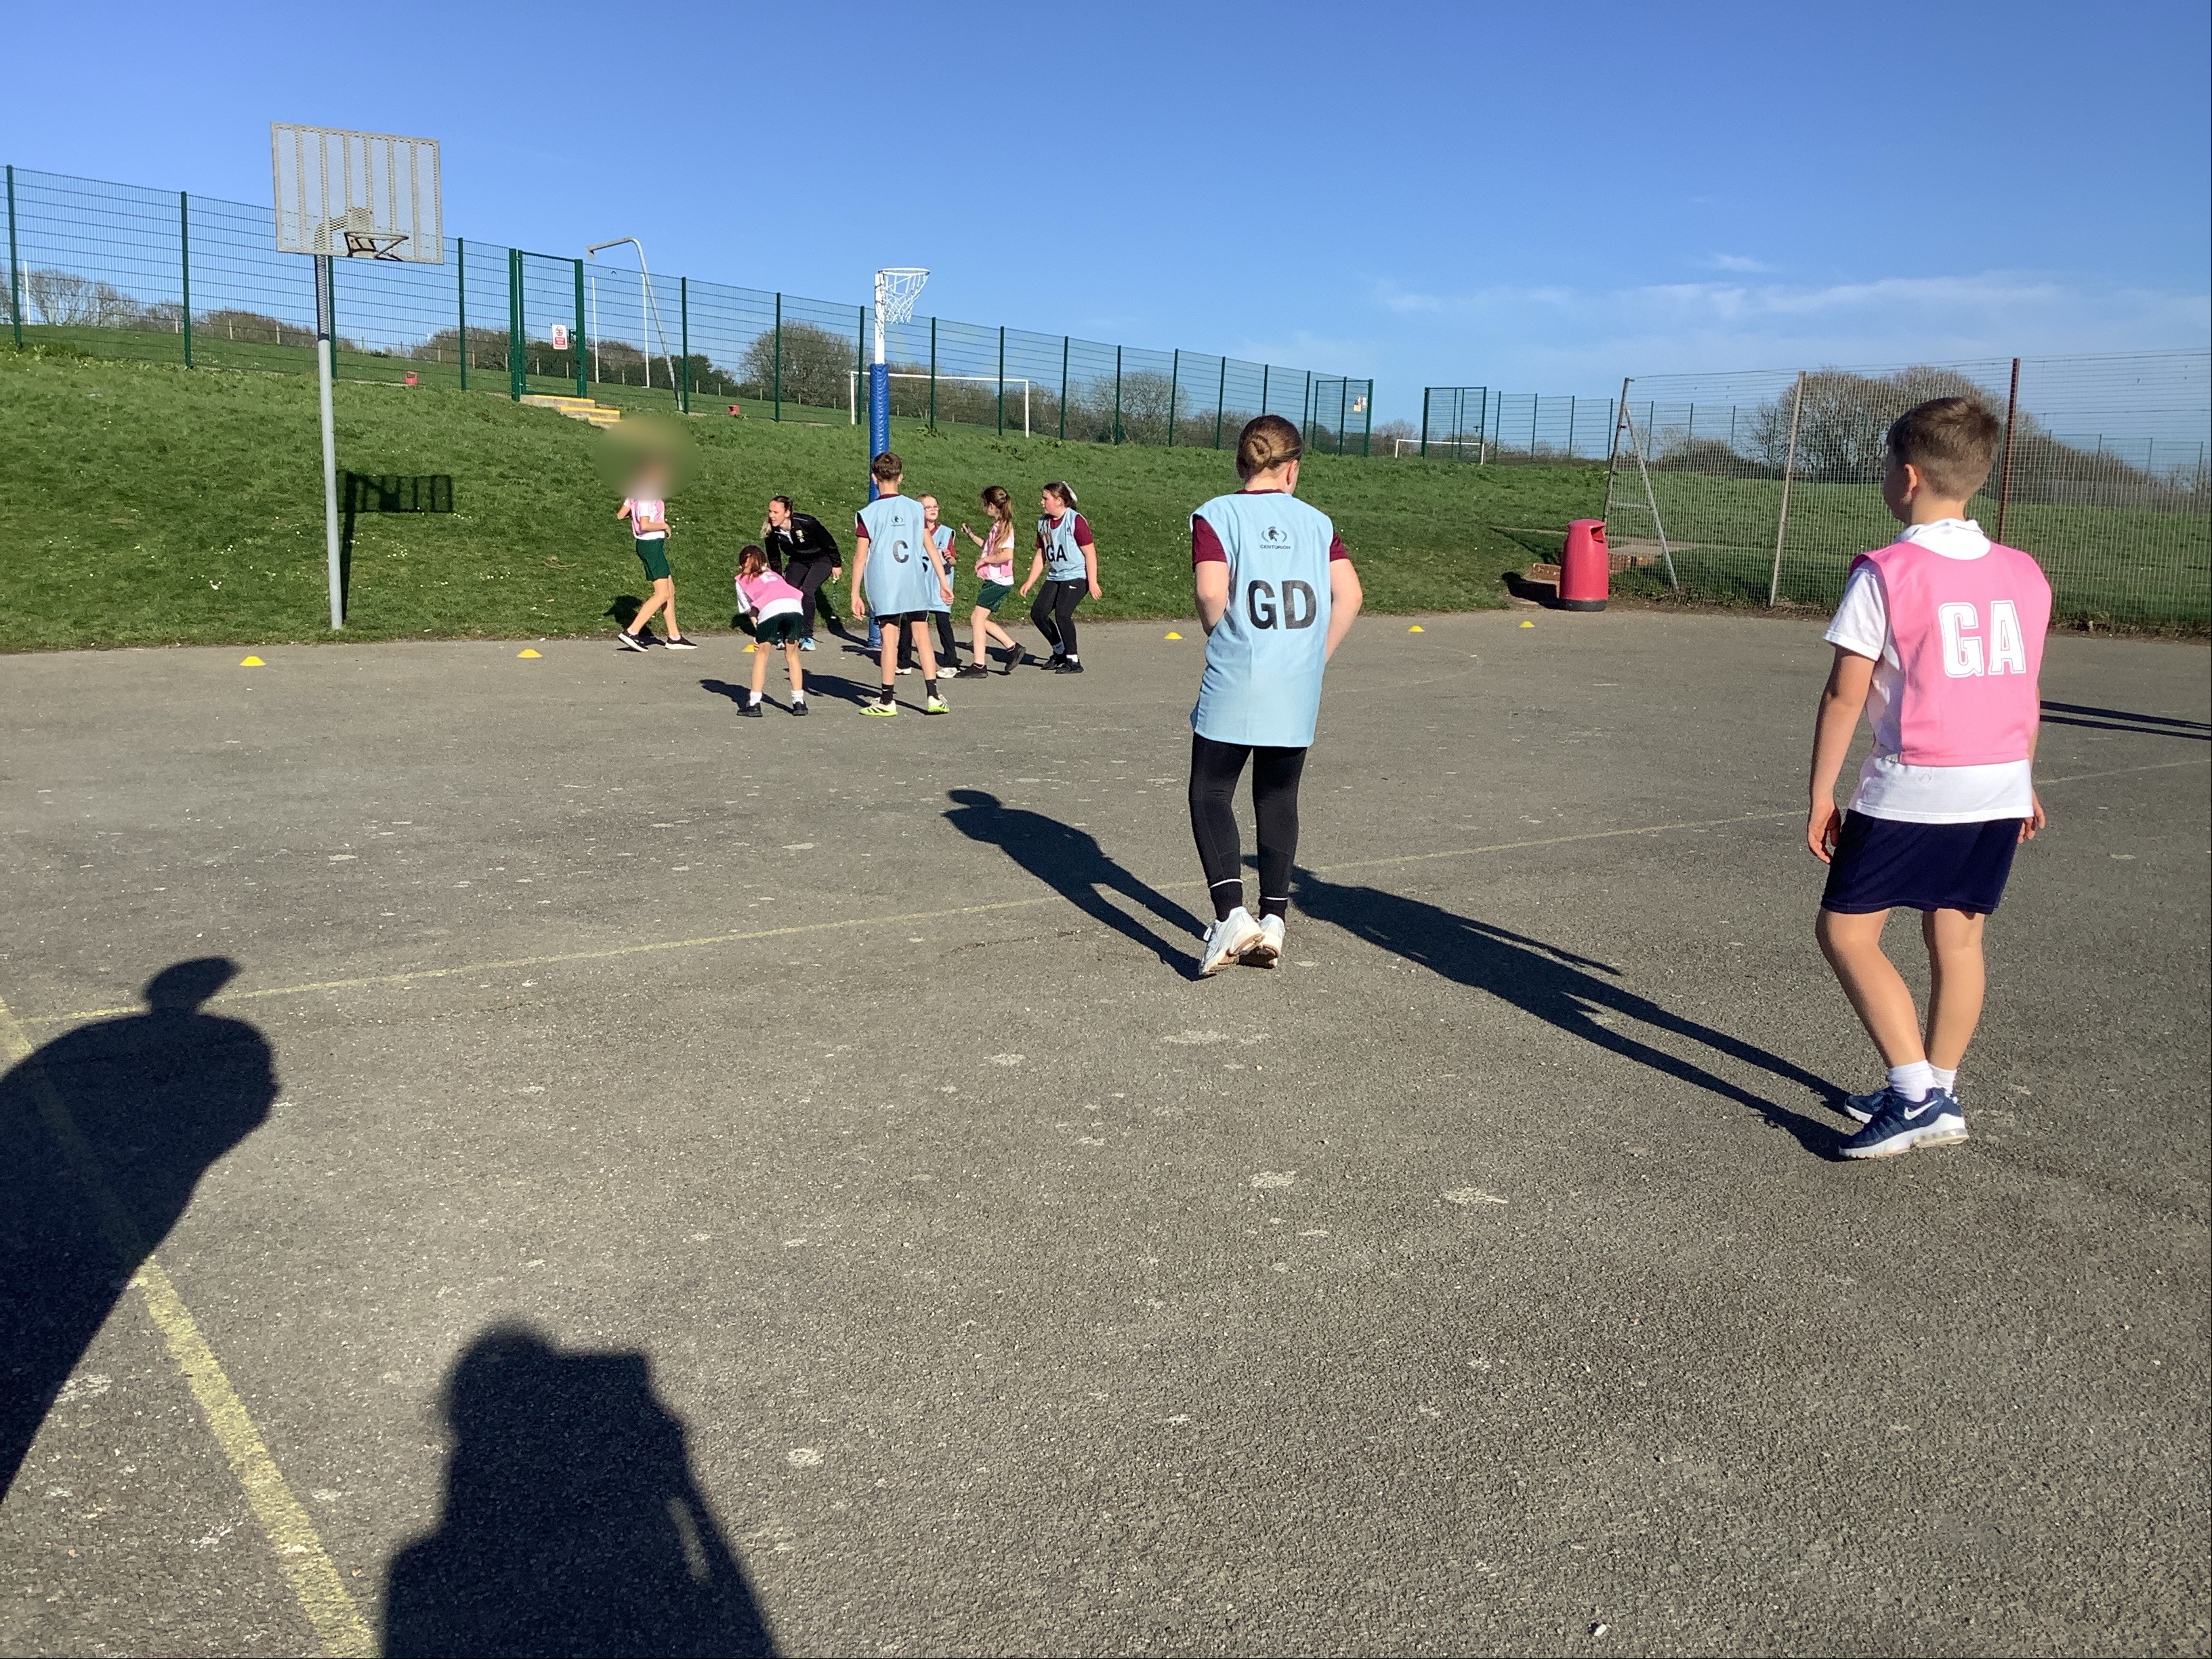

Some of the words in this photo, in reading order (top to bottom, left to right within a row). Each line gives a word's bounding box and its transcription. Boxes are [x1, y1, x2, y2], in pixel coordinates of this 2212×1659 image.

[892, 540, 909, 564] C
[1046, 544, 1068, 562] GA
[1246, 580, 1317, 630] GD
[1938, 600, 2026, 678] GA
